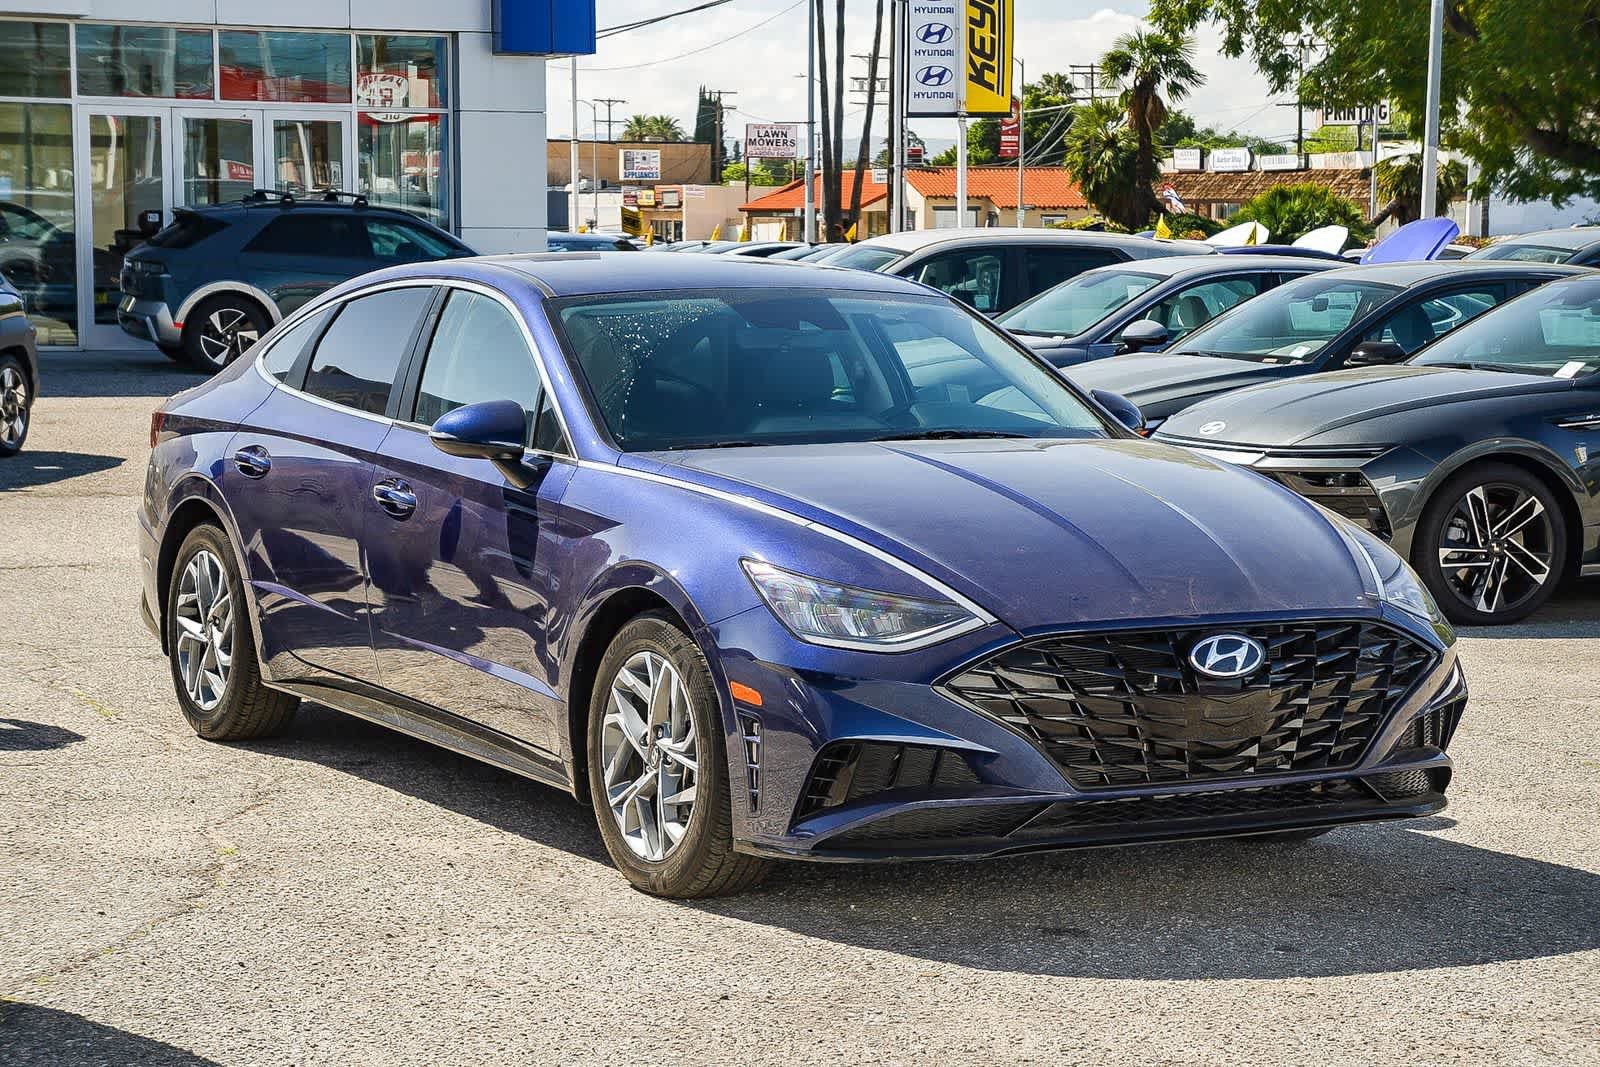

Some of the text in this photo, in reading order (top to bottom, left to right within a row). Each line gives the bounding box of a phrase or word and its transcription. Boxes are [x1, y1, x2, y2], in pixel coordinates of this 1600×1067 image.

[914, 6, 954, 14] HYUNDAI
[968, 0, 998, 92] KEY
[914, 49, 954, 57] HYUNDAI
[913, 91, 954, 99] HYUNDAI
[1325, 104, 1387, 121] PRINTING
[757, 129, 788, 138] LAWN
[748, 138, 796, 147] MOWERS
